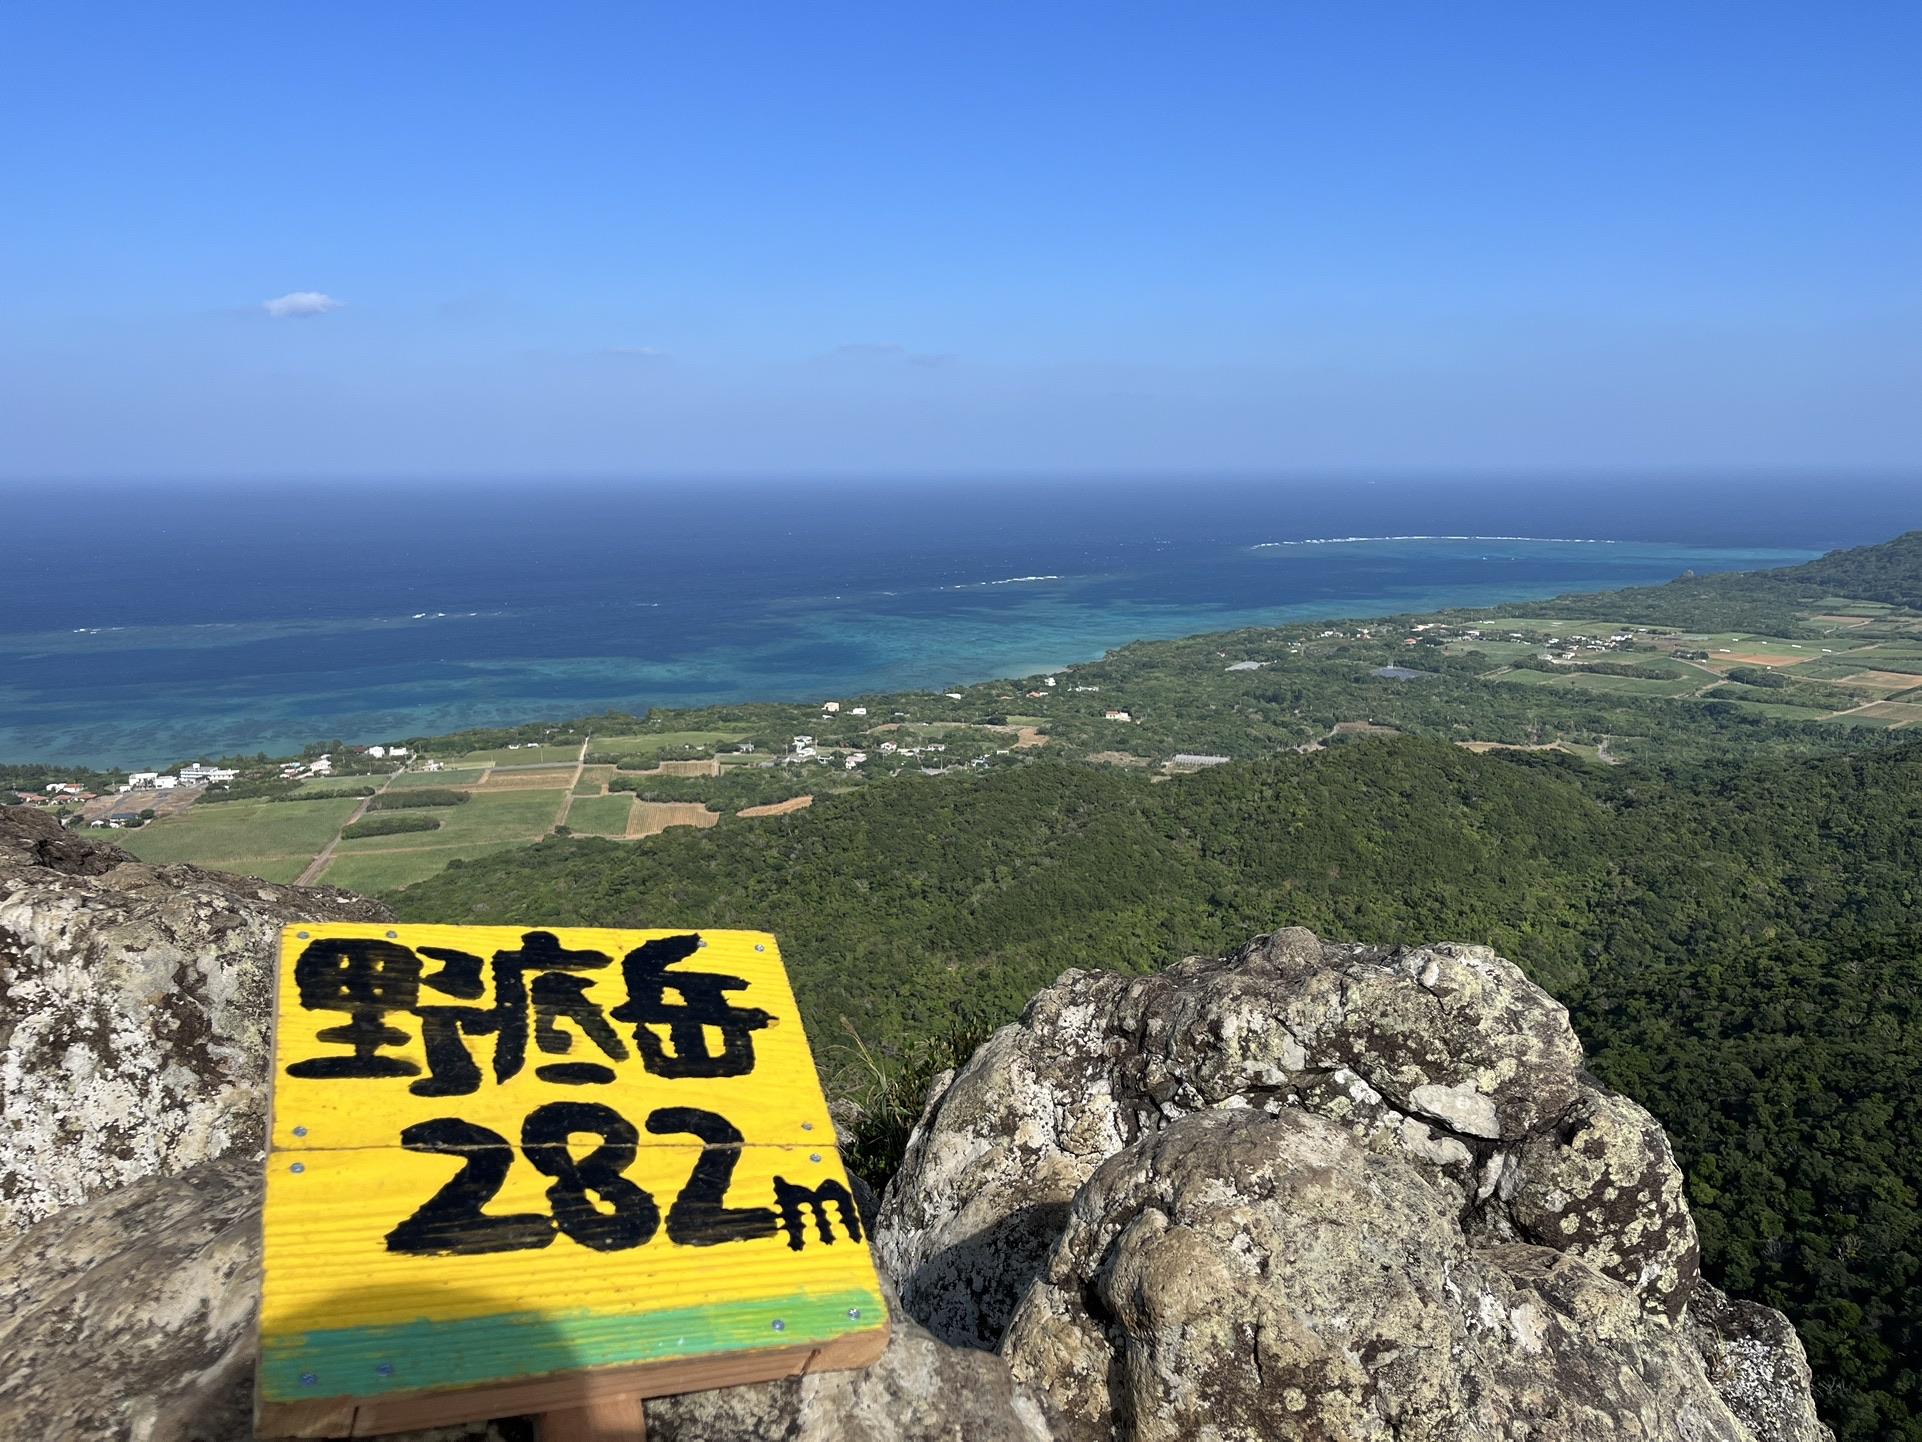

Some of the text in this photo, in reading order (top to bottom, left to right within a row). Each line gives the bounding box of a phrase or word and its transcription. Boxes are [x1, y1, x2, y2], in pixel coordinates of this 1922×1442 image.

[286, 930, 779, 1097] 野底岳
[384, 1101, 862, 1255] 282m
